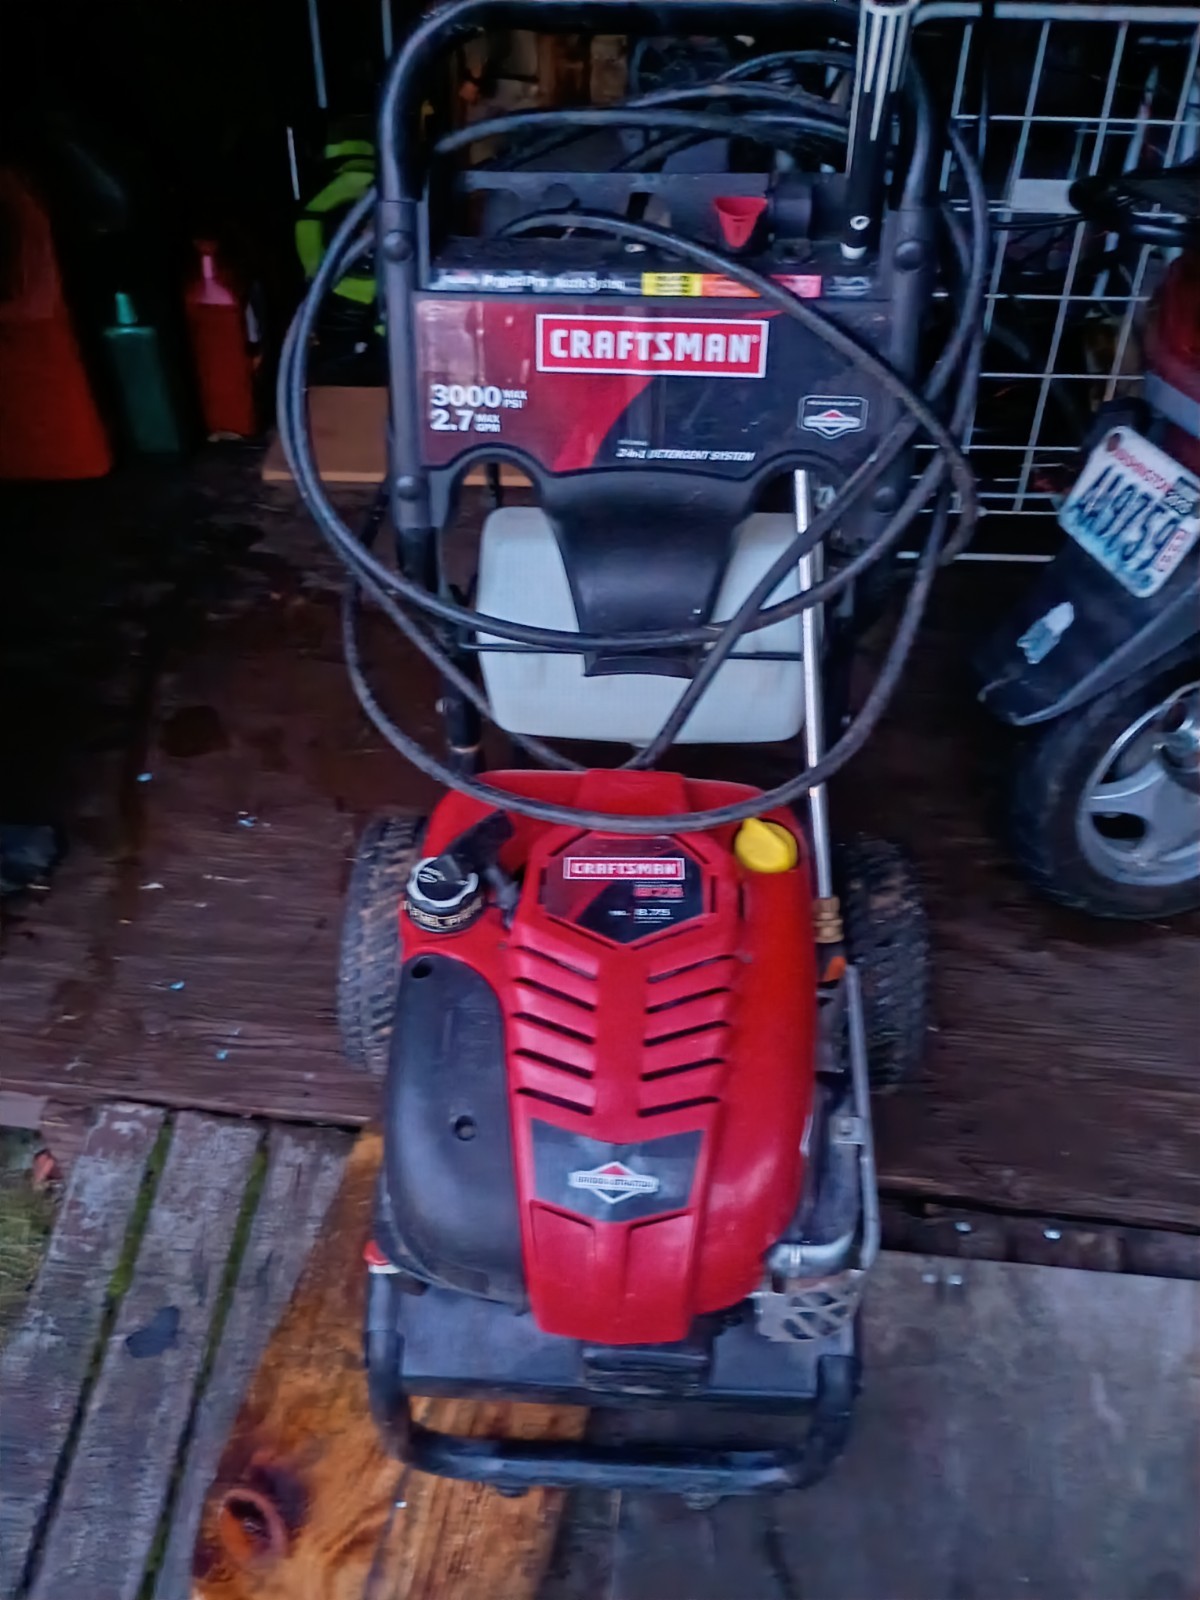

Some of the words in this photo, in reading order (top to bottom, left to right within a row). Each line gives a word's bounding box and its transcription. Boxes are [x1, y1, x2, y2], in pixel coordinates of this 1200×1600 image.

[550, 329, 751, 363] CRAFTSMAN
[430, 384, 502, 409] 3000
[502, 389, 527, 400] MAX
[503, 399, 523, 409] PSI
[430, 408, 474, 432] 2.7
[474, 413, 500, 423] MAX
[474, 423, 501, 433] GPM
[646, 449, 709, 460] DETERGENT
[708, 451, 756, 461] SYSTEM
[570, 862, 677, 875] CRAFTSMAN
